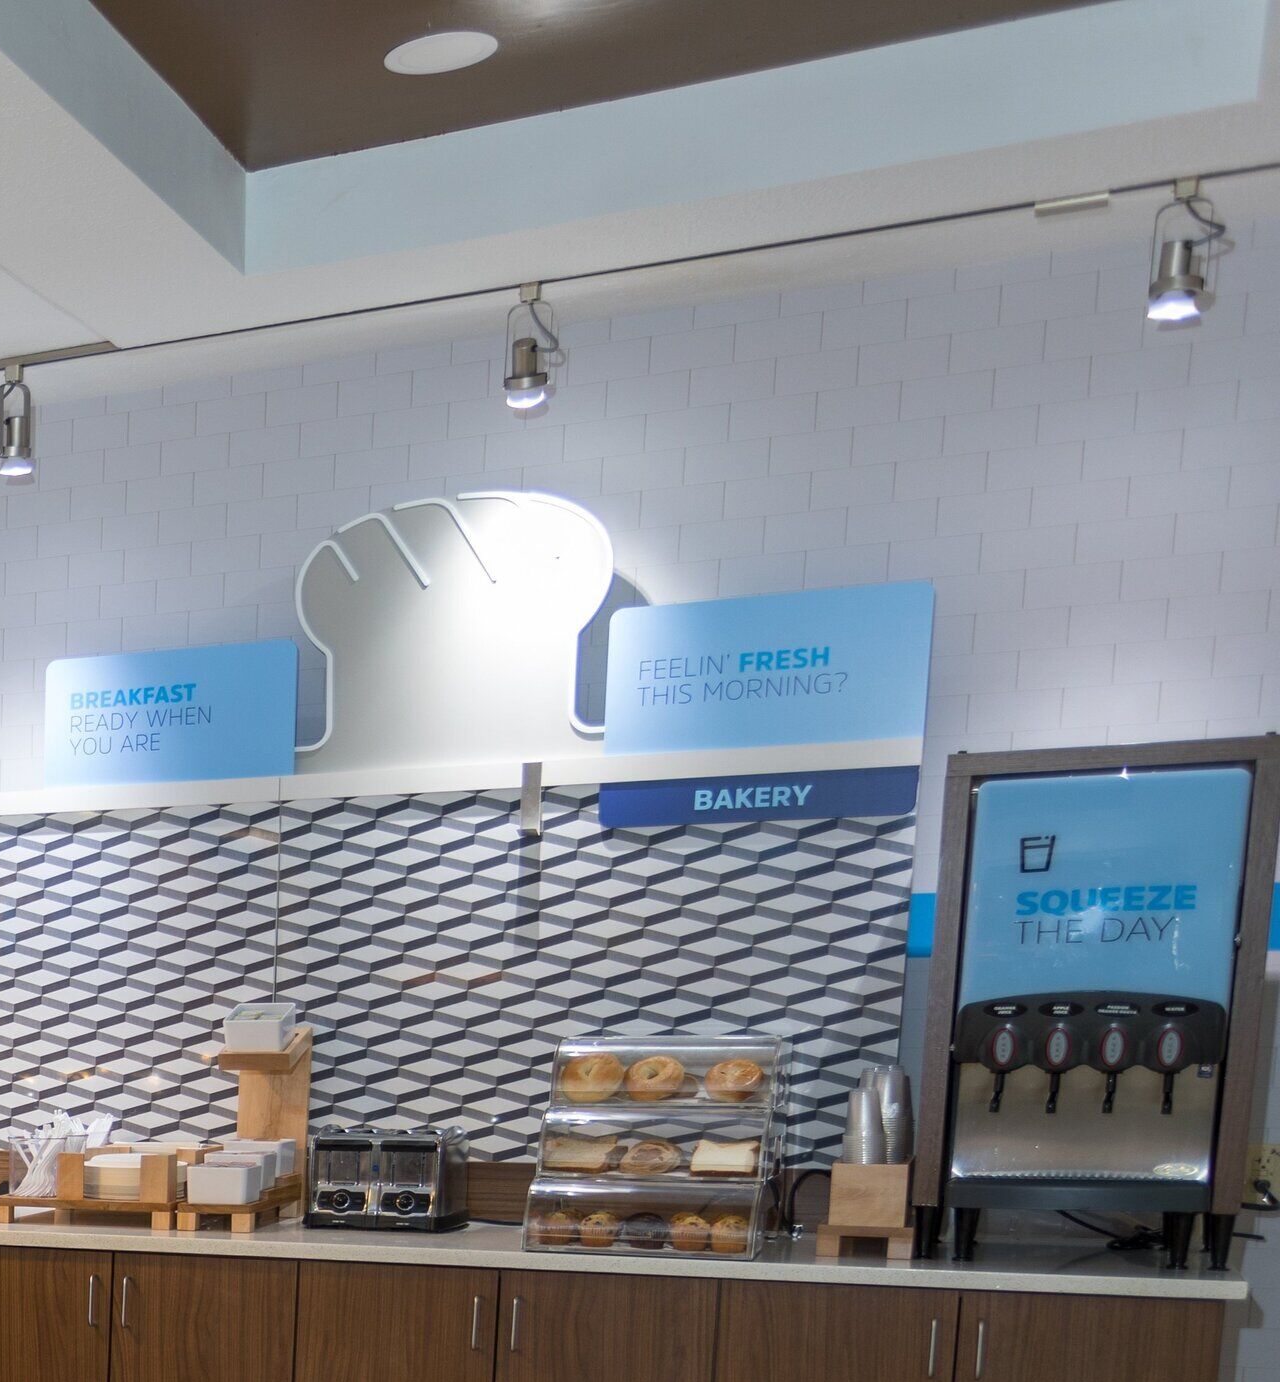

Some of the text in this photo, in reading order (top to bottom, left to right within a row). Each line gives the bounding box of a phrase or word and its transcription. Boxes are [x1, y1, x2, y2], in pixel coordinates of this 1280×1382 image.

[739, 646, 830, 673] FRESH
[70, 683, 197, 710] BREAKFAST
[637, 671, 848, 706] THIS MORNING?
[70, 705, 212, 733] READY WHEN
[70, 733, 160, 756] YOU ARE
[694, 785, 813, 811] BAKERY
[1015, 885, 1197, 916] SQUEEZE
[1014, 917, 1175, 944] THE DAY
